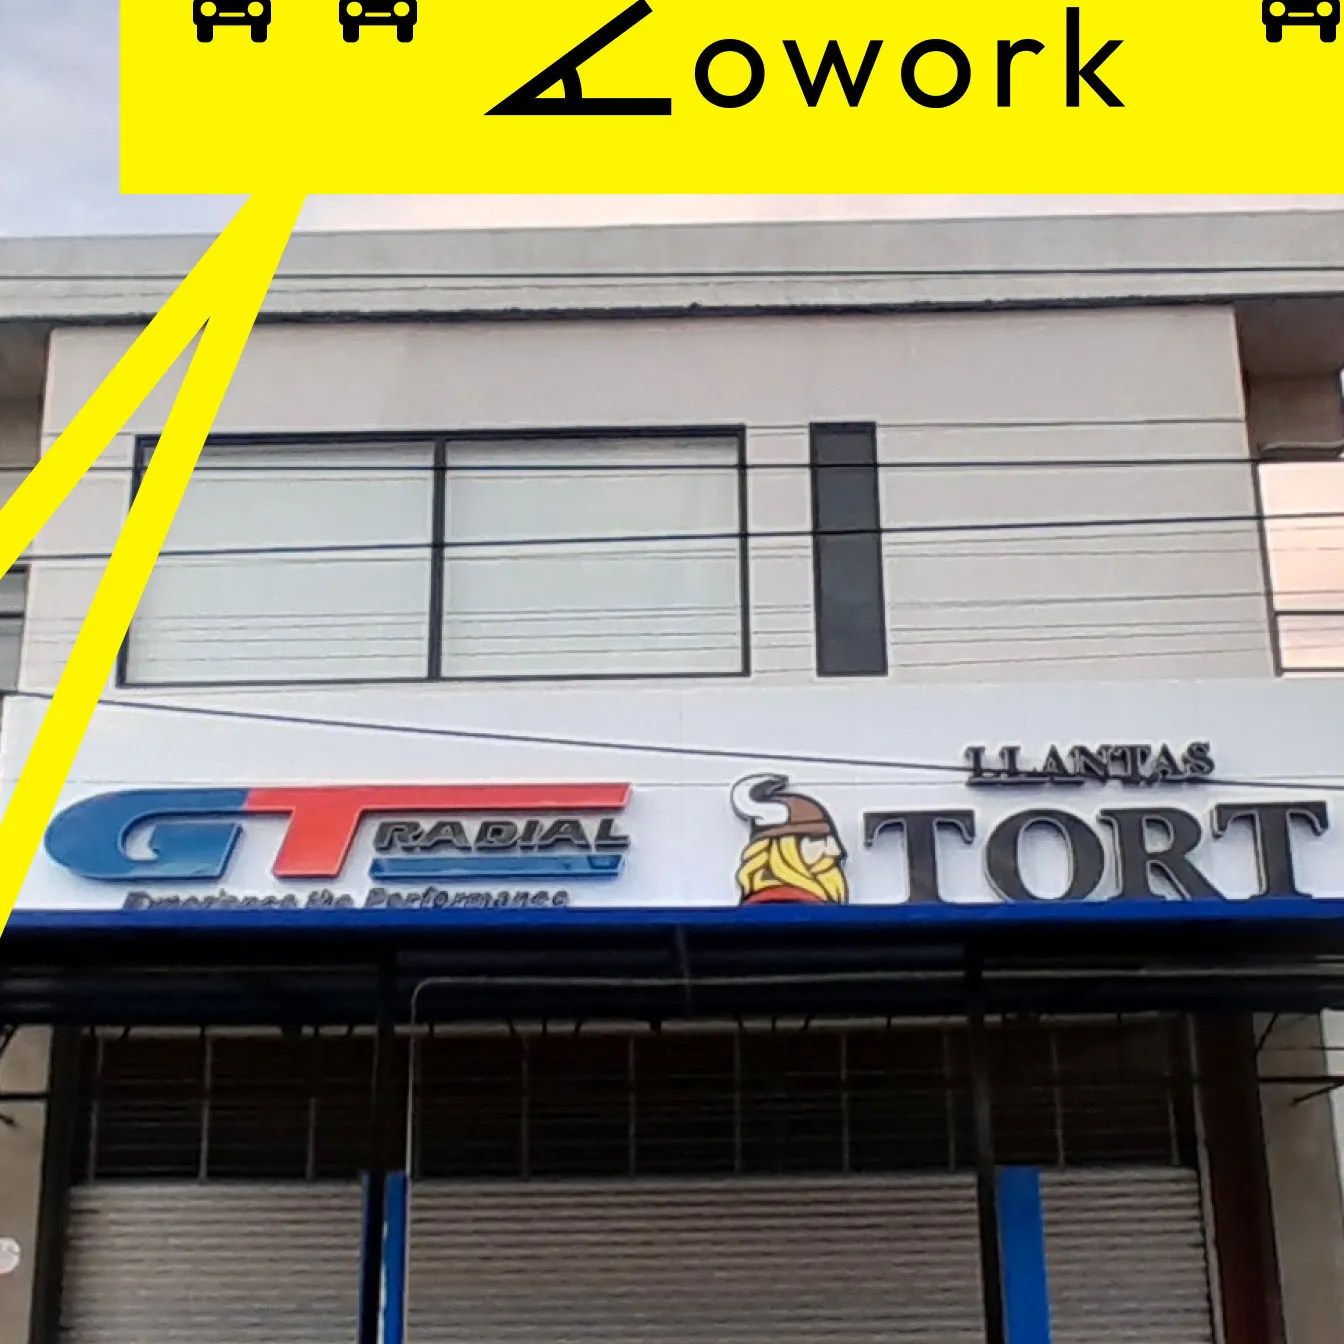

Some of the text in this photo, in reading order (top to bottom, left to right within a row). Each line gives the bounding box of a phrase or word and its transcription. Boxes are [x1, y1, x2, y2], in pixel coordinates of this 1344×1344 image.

[964, 741, 1216, 787] LLANTAS
[43, 782, 632, 880] GT
[372, 816, 631, 853] RADIAL
[862, 799, 1330, 903] TORT
